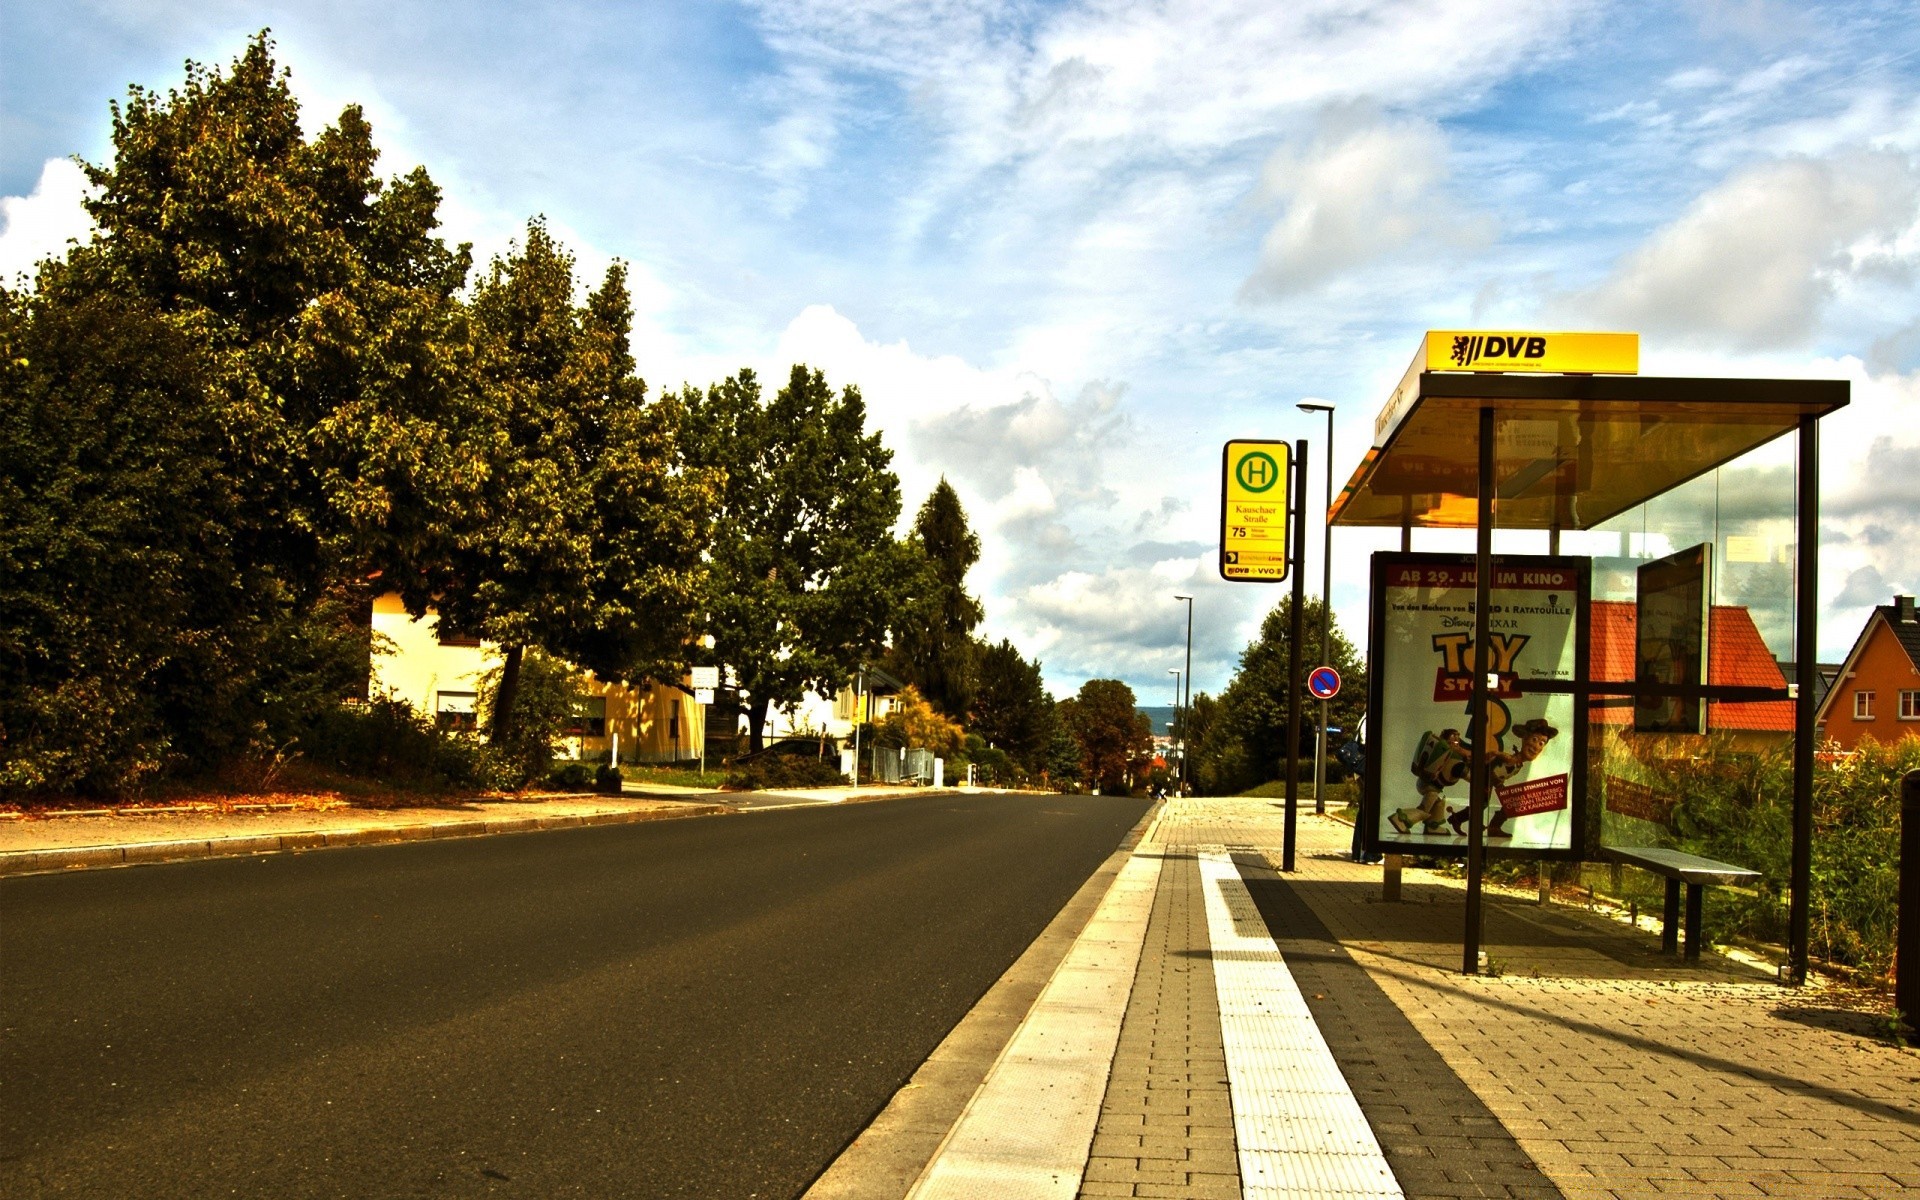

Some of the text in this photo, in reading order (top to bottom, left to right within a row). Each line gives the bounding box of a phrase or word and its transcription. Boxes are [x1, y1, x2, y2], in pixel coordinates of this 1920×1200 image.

[1483, 336, 1546, 358] DVB
[1248, 461, 1266, 484] H
[1236, 505, 1276, 515] Kauschaer
[1243, 515, 1268, 523] Straße
[1232, 527, 1246, 537] 75
[1400, 571, 1421, 582] AB
[1428, 571, 1454, 583] 29.
[1498, 573, 1517, 584] IM
[1523, 573, 1564, 585] KINO
[1490, 619, 1518, 628] IXAR
[1432, 632, 1531, 675] TOY
[1443, 678, 1512, 692] STY
[1523, 782, 1549, 792] STIMMEN
[1550, 778, 1564, 786] VON
